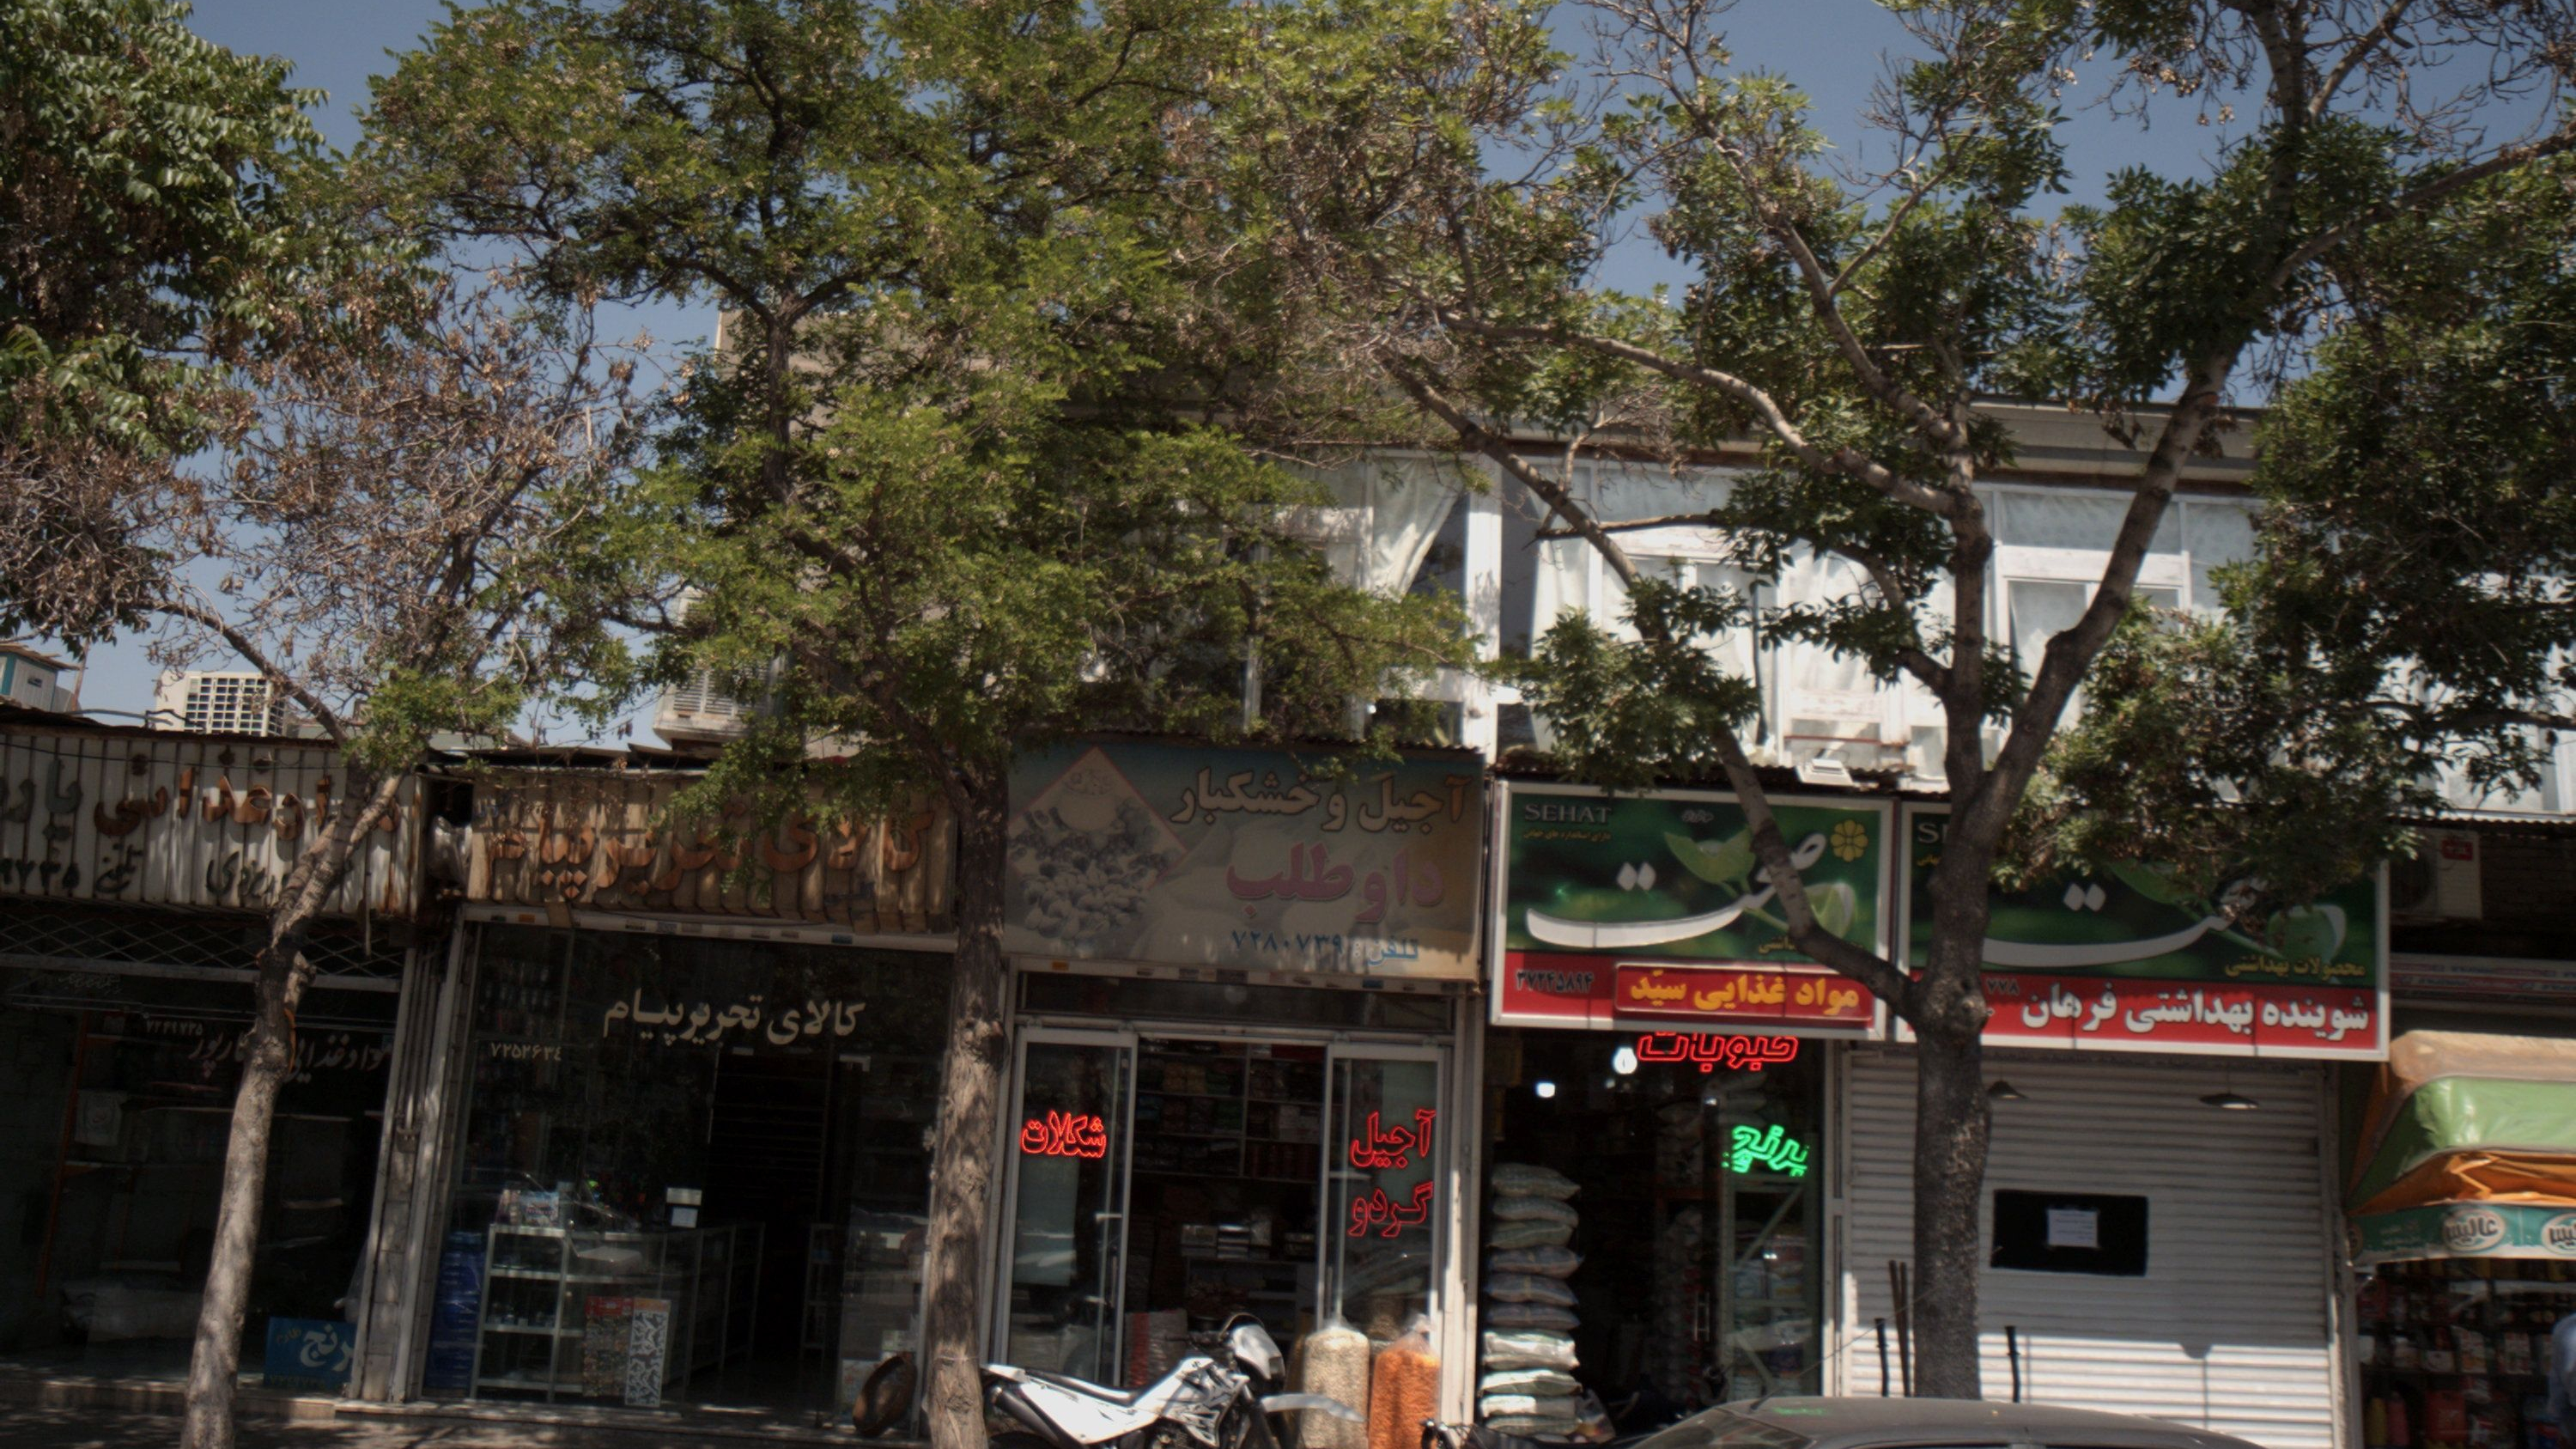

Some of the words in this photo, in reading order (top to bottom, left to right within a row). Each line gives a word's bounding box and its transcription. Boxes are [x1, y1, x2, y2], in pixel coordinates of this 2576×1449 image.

[1170, 767, 1321, 825] خشکبار
[1321, 785, 1349, 832] و
[1358, 773, 1473, 835] آجیل
[1524, 803, 1613, 825] SEHAT
[1225, 841, 1446, 924] داوطلب
[1693, 971, 1786, 1012] غذایی
[1795, 977, 1861, 1016] مواد
[2021, 982, 2118, 1032] فرهان
[2124, 989, 2255, 1034] بهداشتی
[603, 988, 684, 1046] پیام
[684, 993, 763, 1045] تحریر
[766, 999, 866, 1045] کالای
[2260, 996, 2370, 1042] شوینده
[1636, 1032, 1799, 1074] حبوبات
[1020, 1111, 1109, 1160] شکلات
[1349, 1108, 1437, 1169] آجیل
[1348, 1180, 1434, 1238] گردو
[300, 1323, 355, 1373] رنج
